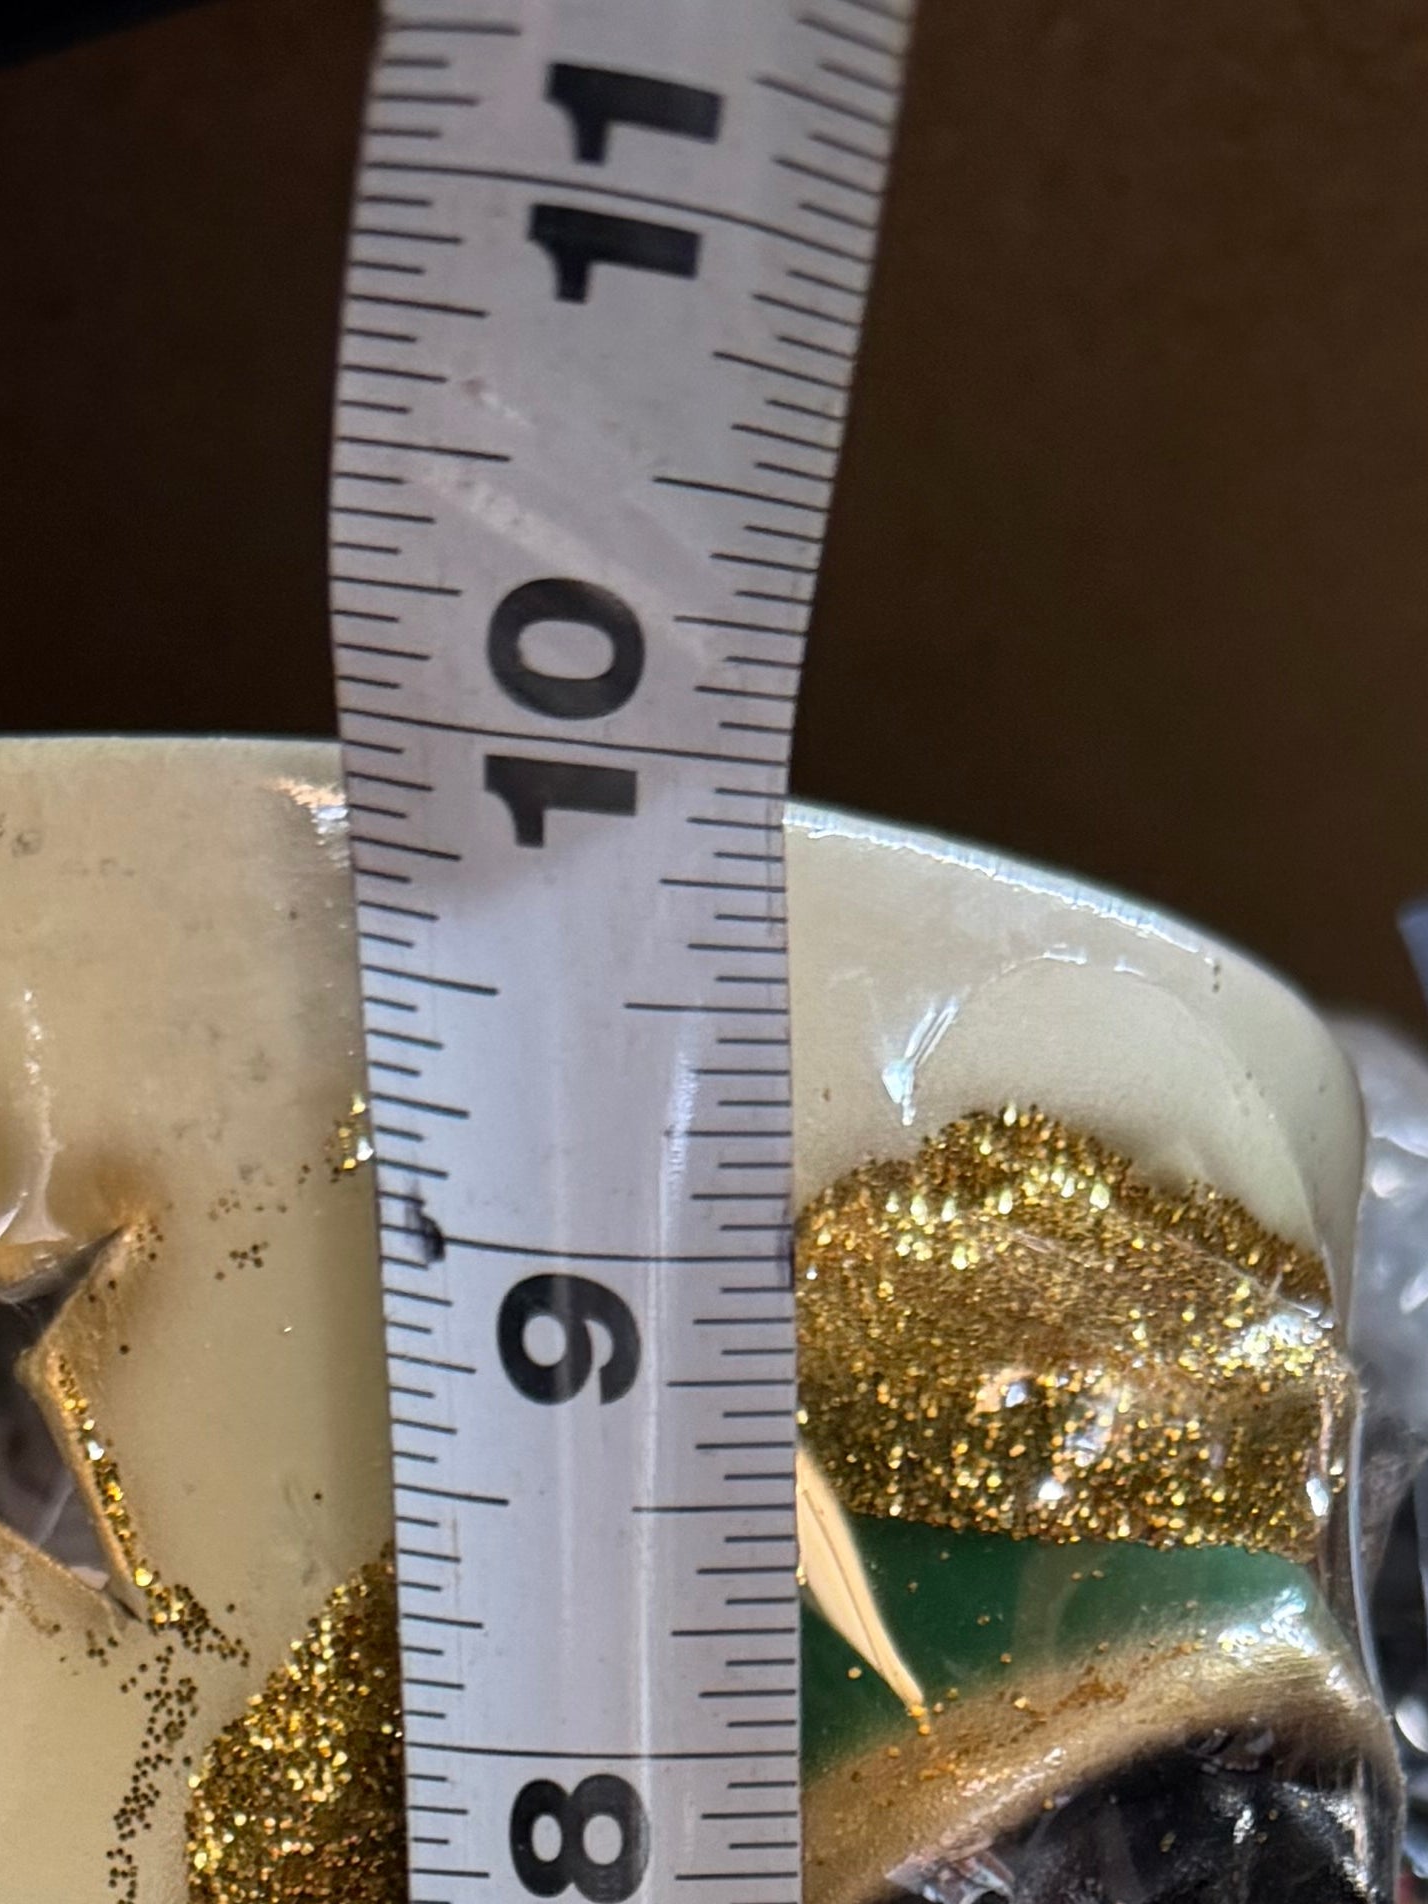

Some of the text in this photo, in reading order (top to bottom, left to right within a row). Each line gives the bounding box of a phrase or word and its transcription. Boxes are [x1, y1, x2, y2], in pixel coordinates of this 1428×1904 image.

[527, 61, 724, 304] 11
[484, 577, 646, 848] 10
[497, 1273, 642, 1405] 9
[510, 1773, 650, 1904] 8
